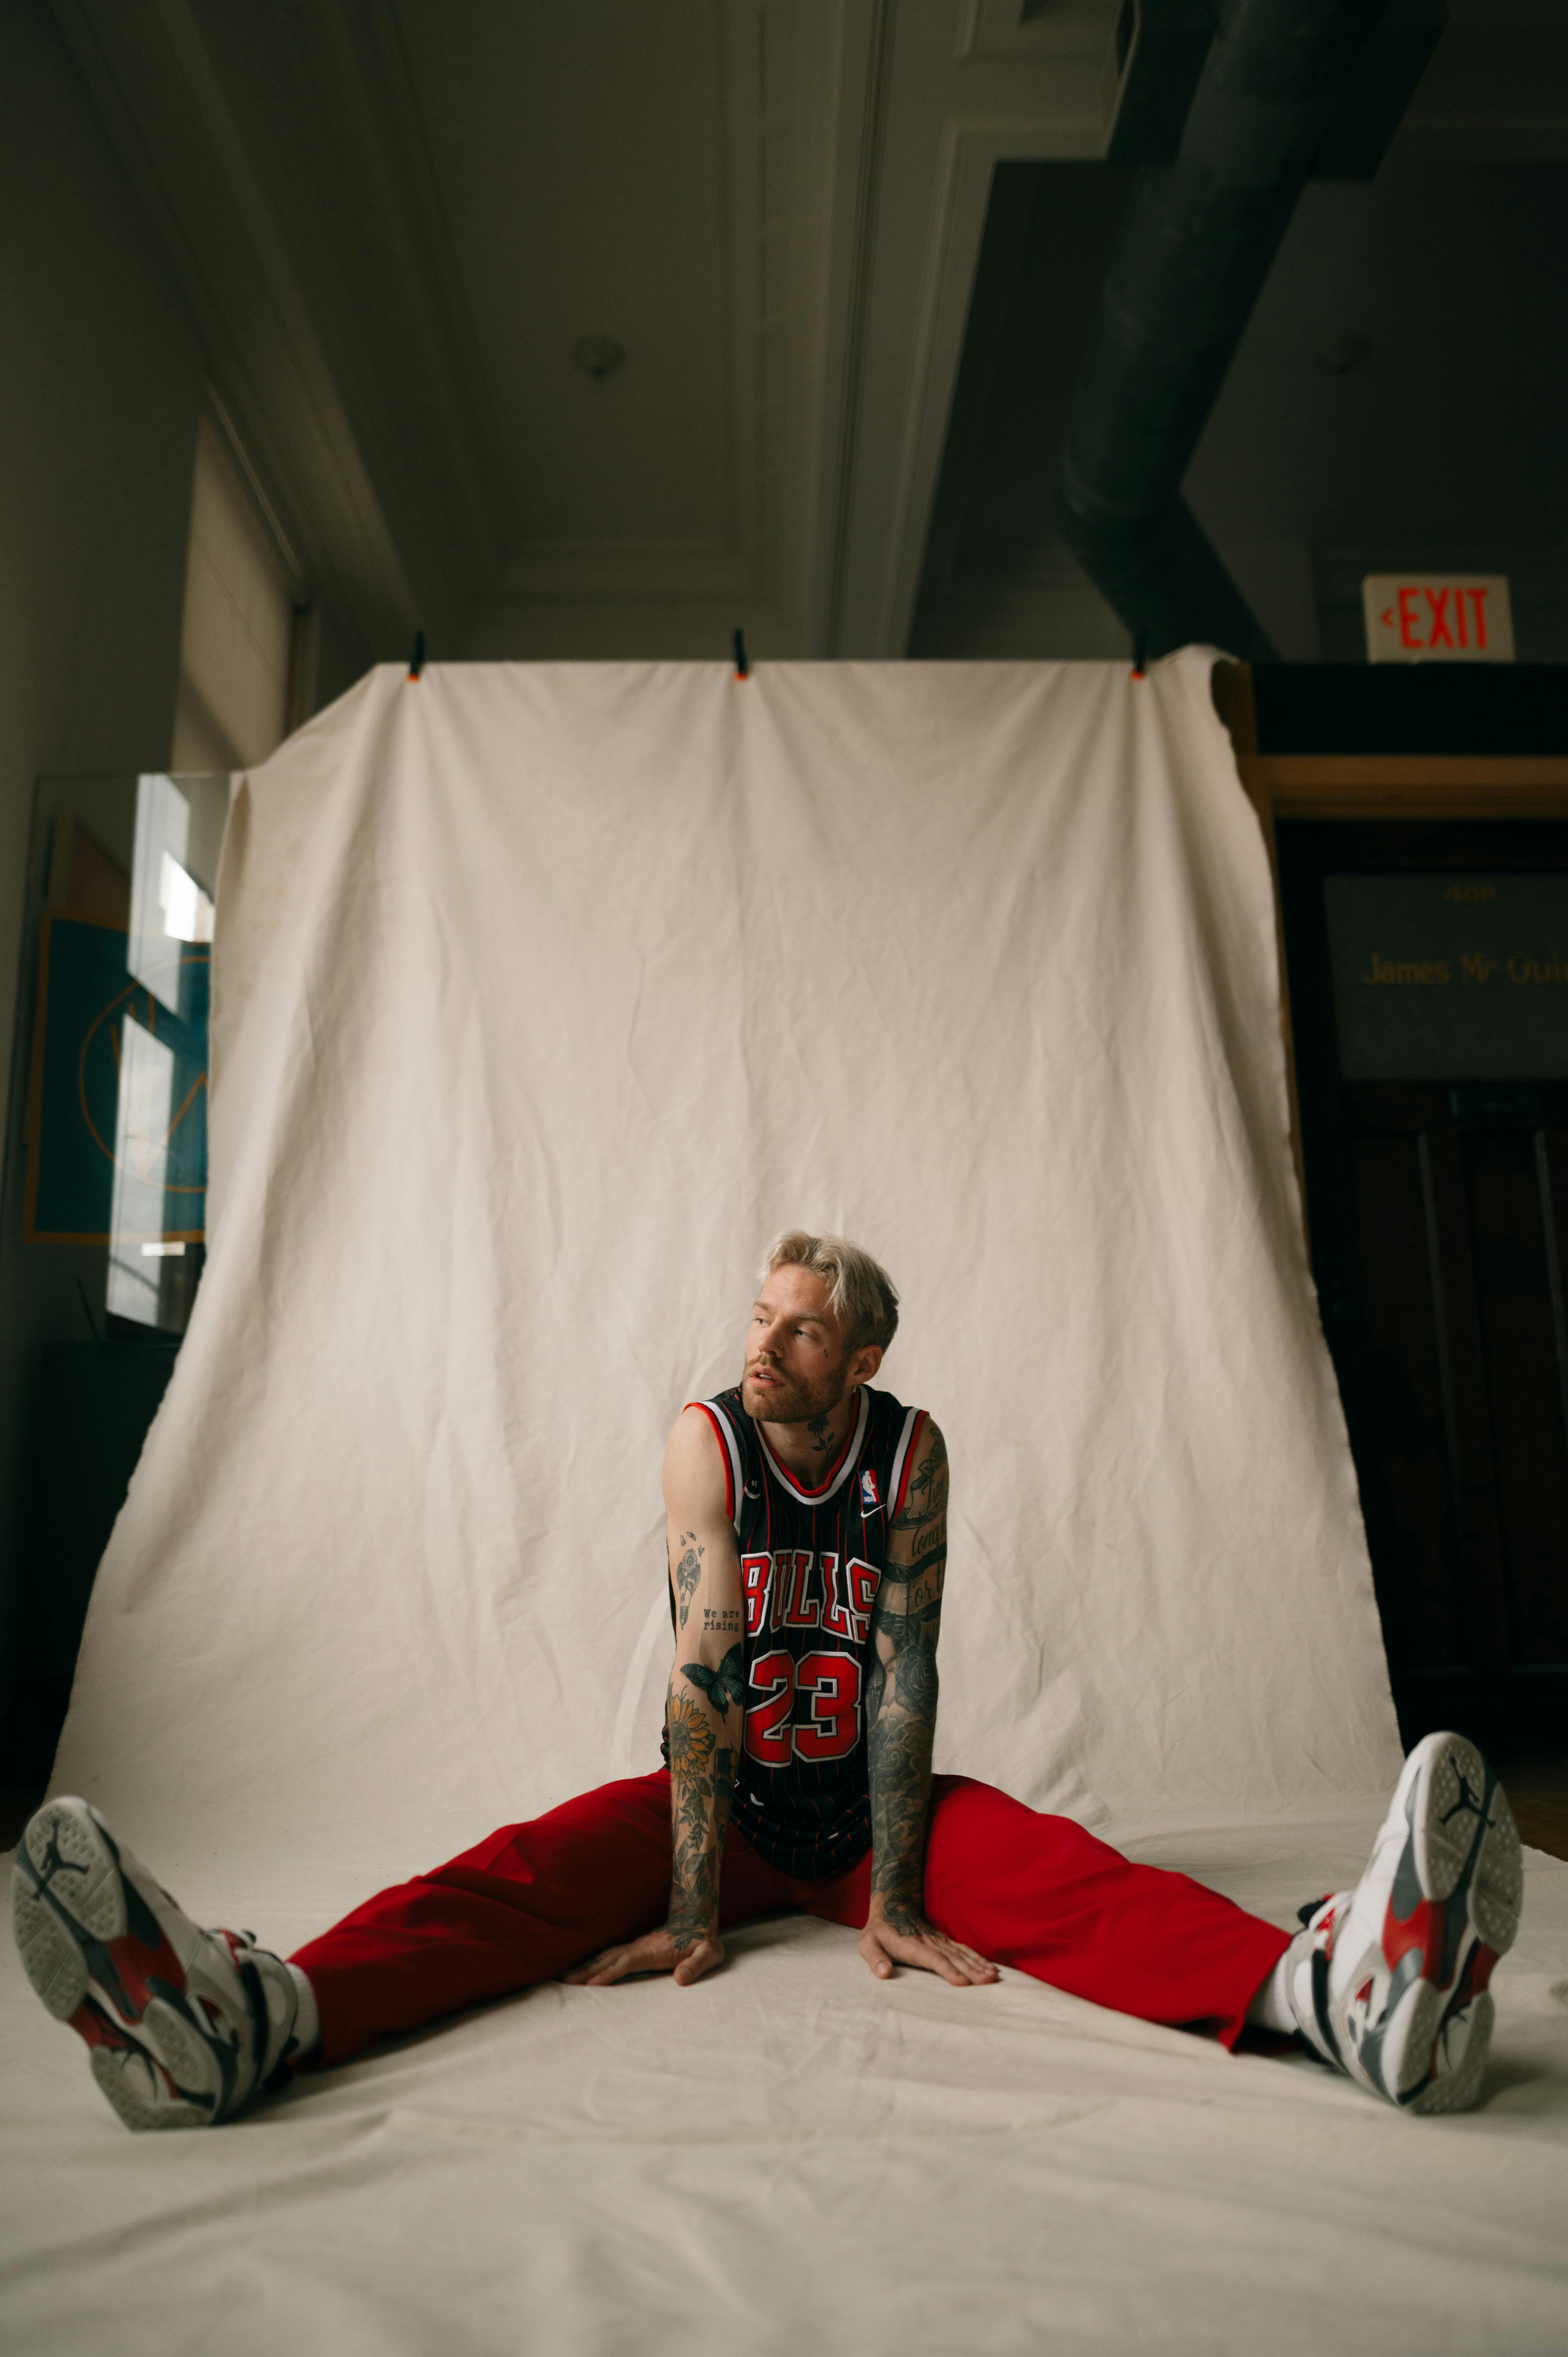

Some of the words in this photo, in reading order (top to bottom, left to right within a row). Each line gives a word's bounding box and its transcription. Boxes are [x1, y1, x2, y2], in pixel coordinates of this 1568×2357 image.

[1397, 587, 1488, 649] EXIT
[1363, 952, 1451, 985] James
[704, 1609, 717, 1618] We
[741, 1548, 882, 1644] BULLS
[704, 1619, 740, 1632] rising
[743, 1649, 862, 1768] 23
